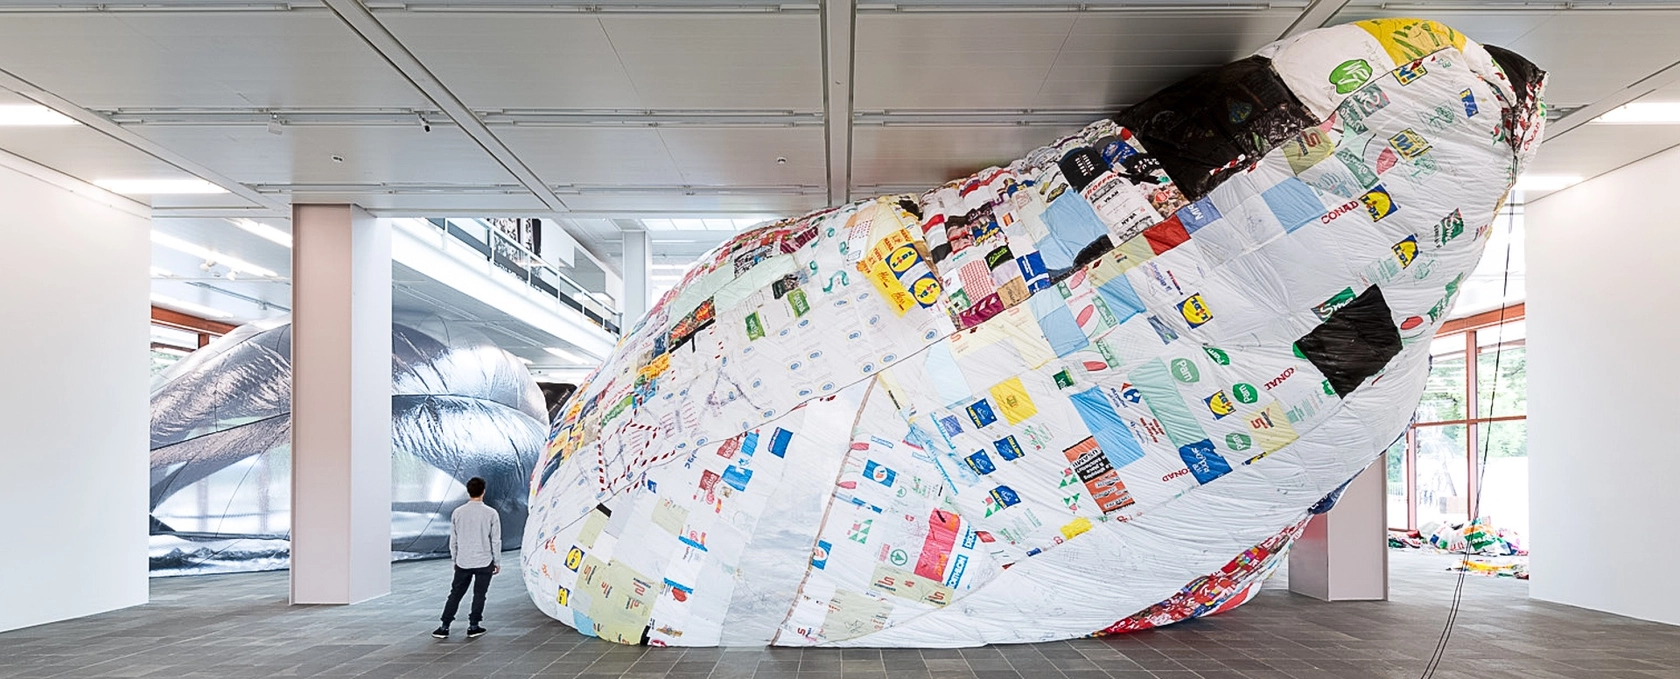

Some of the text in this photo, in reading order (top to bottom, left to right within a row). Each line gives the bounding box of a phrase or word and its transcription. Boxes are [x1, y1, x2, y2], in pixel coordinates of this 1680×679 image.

[1320, 200, 1360, 225] CONAD
[1177, 359, 1194, 382] Pam
[1238, 384, 1253, 404] Pam
[1231, 434, 1246, 451] Pam
[1161, 468, 1191, 483] ONAD
